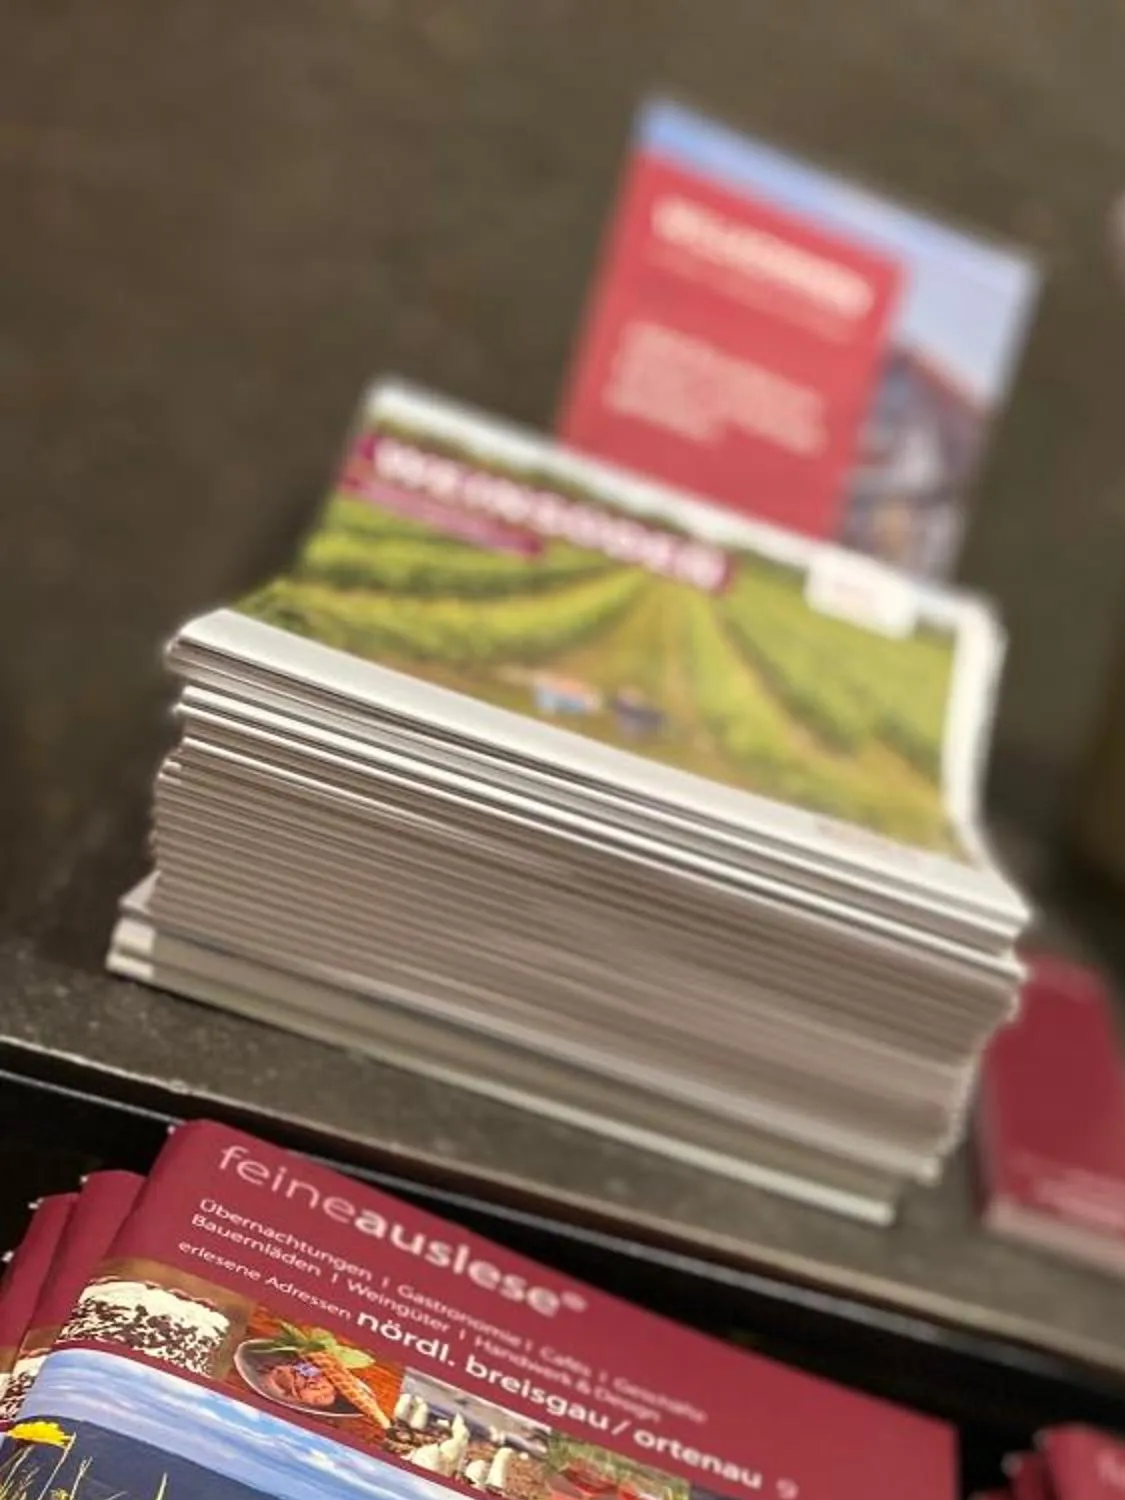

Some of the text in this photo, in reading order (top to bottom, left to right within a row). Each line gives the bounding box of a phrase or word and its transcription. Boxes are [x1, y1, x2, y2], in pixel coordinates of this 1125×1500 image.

[178, 1241, 262, 1281] erlesene
[265, 1276, 352, 1320] Adressen
[356, 1311, 456, 1367] nördl.
[191, 1213, 322, 1277] Bauernläden
[347, 1278, 451, 1333] Weingüter
[199, 1197, 373, 1282] Übernachtungen
[397, 1284, 522, 1347] Gastronomie
